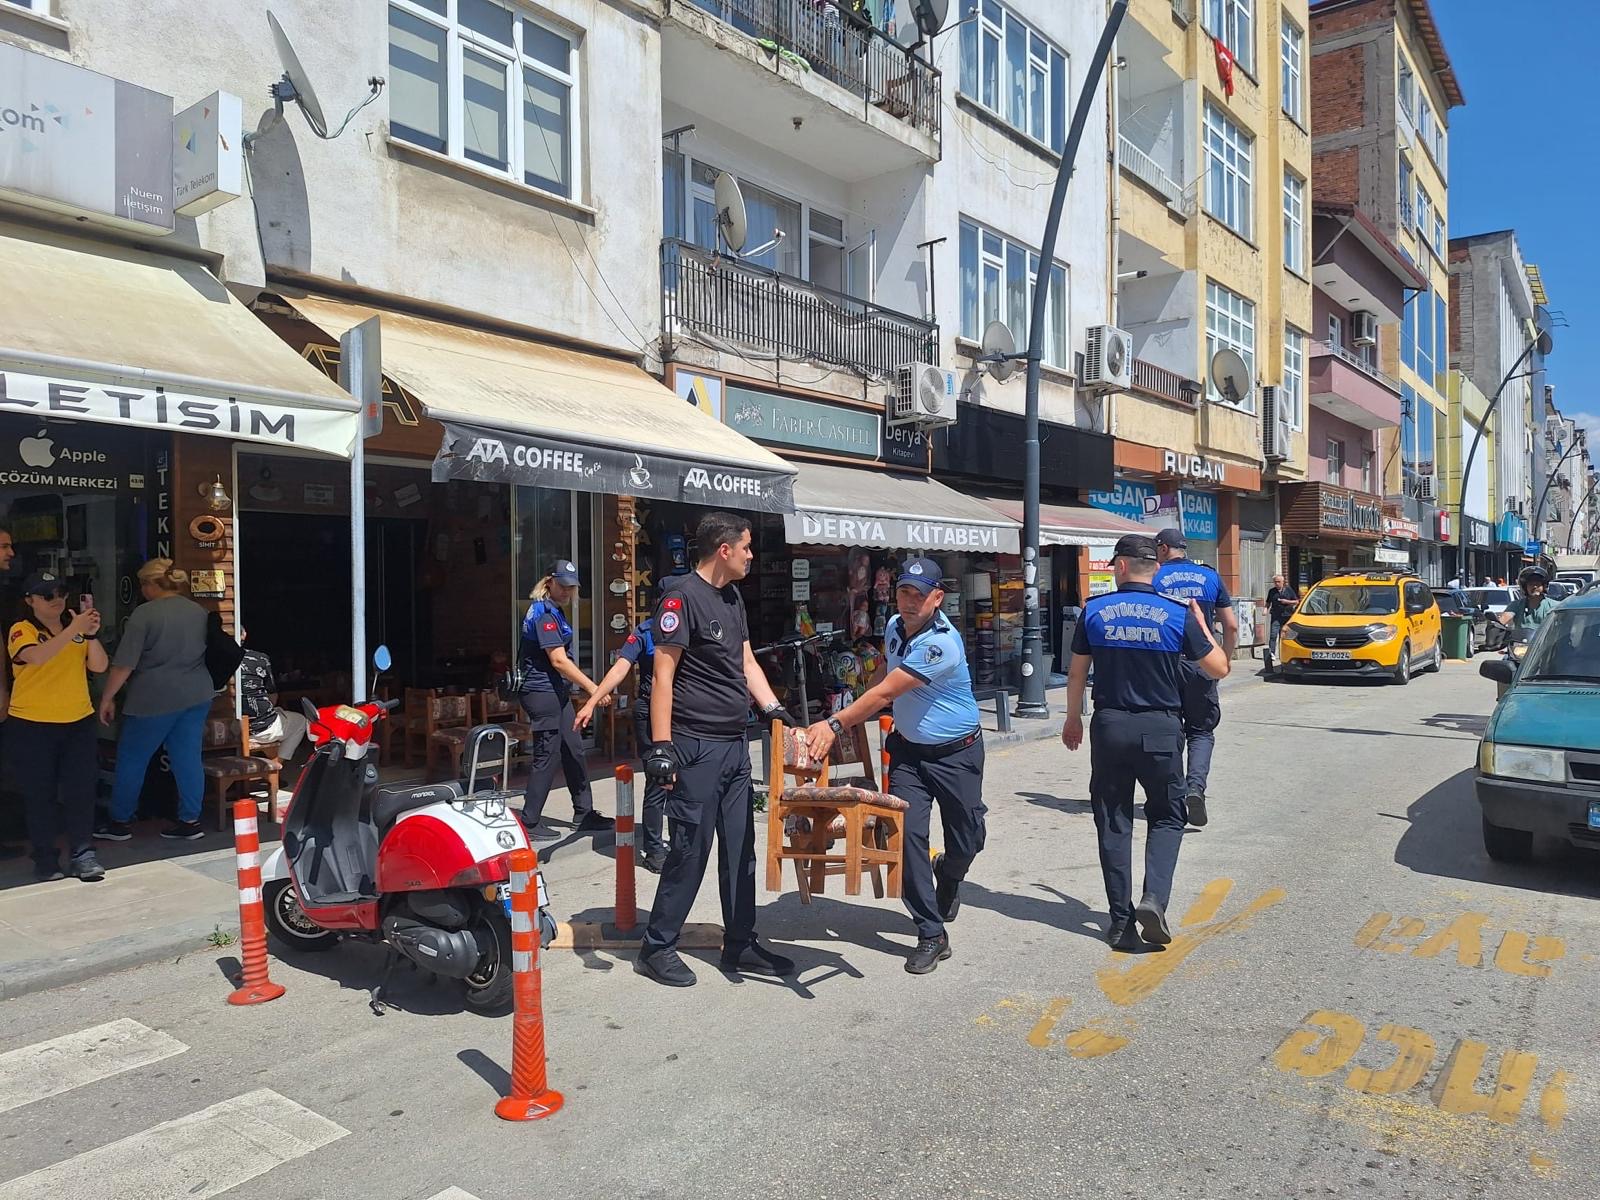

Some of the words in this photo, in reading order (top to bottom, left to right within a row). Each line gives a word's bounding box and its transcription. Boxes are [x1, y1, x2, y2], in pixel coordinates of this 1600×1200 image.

[130, 186, 163, 203] Nuem
[885, 425, 921, 448] Derya
[60, 447, 107, 463] Apple
[465, 438, 508, 465] ATA
[513, 445, 583, 473] COFFEE
[1164, 450, 1225, 482] RUGAN
[0, 470, 53, 486] ÇÖZÜM
[58, 476, 118, 489] MERKEZİ
[683, 467, 711, 490] ATA
[713, 473, 761, 497] COFFEE
[802, 517, 886, 541] DERYA
[906, 522, 997, 547] KİTABEVİ
[1104, 625, 1161, 642] ZABITA
